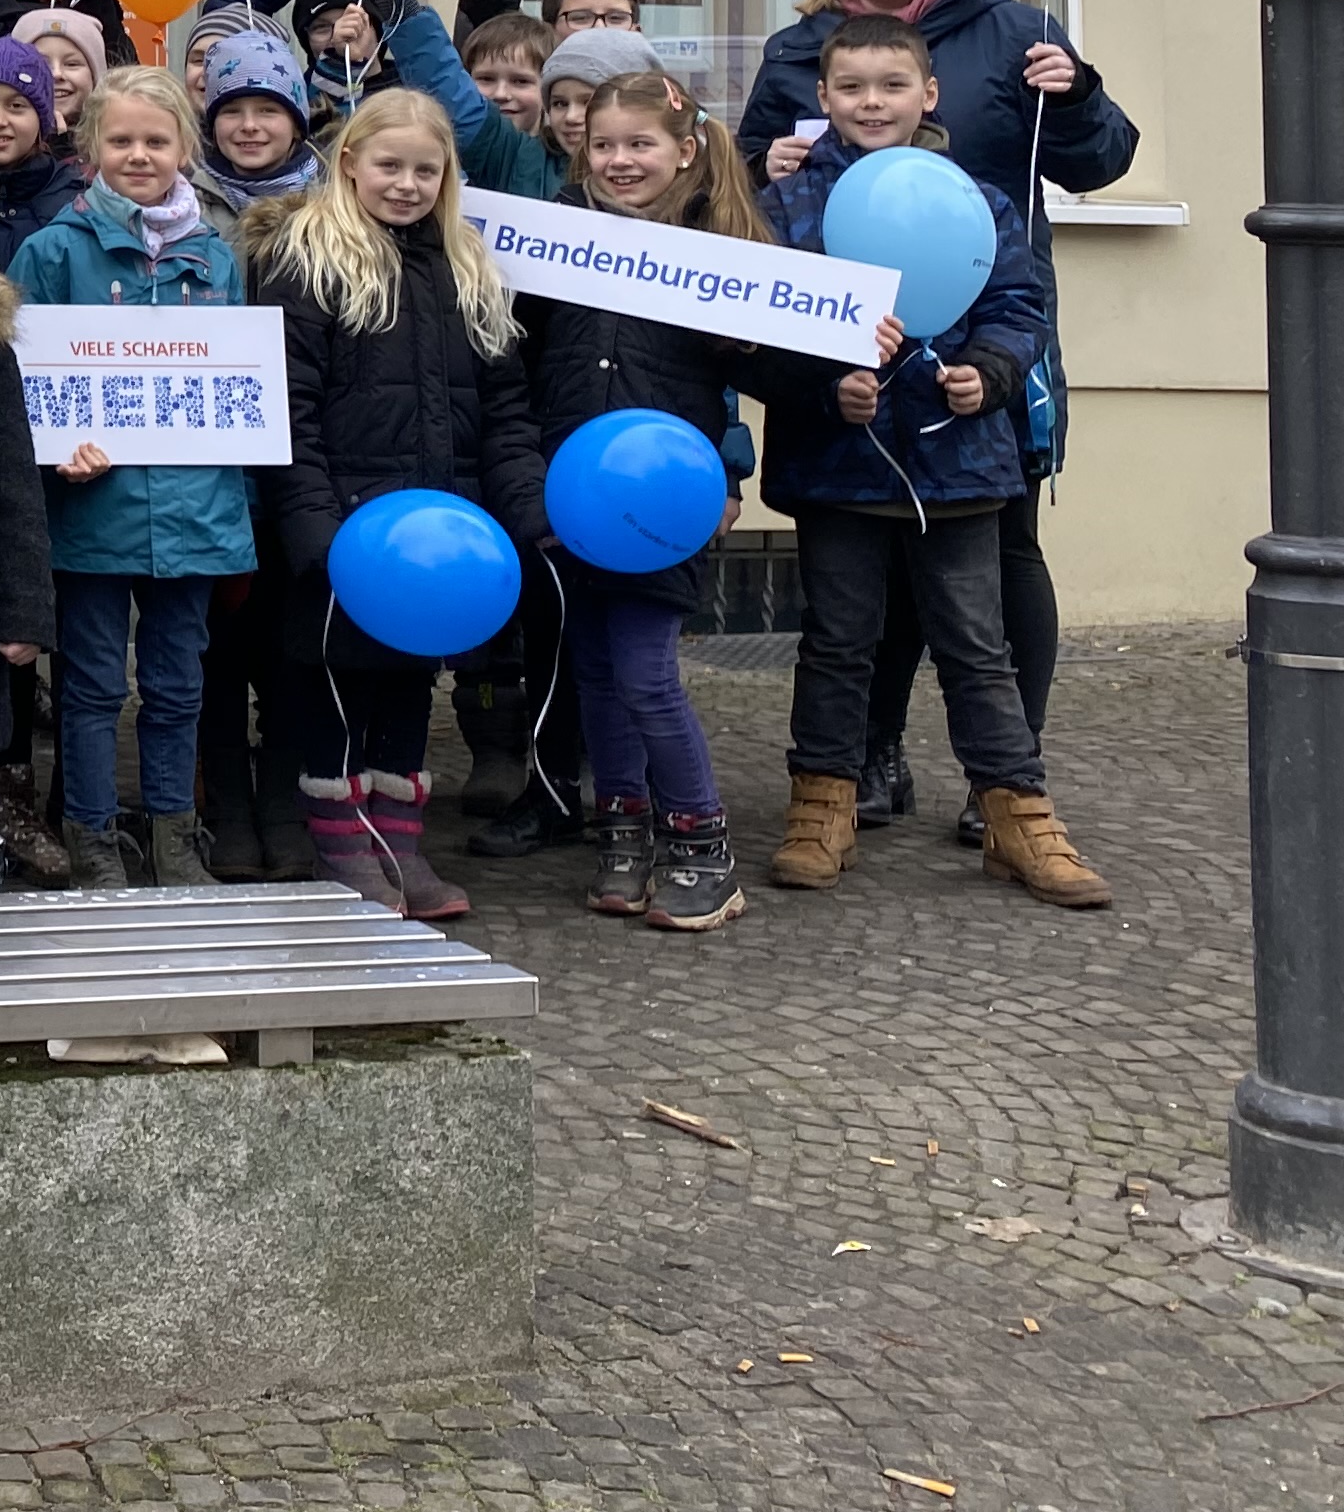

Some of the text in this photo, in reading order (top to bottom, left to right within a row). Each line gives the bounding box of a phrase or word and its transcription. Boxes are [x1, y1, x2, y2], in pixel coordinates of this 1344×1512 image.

[492, 224, 865, 327] Brandenburger Bank
[70, 340, 209, 359] VIELE SCHAFFEN
[23, 374, 266, 431] MEHR
